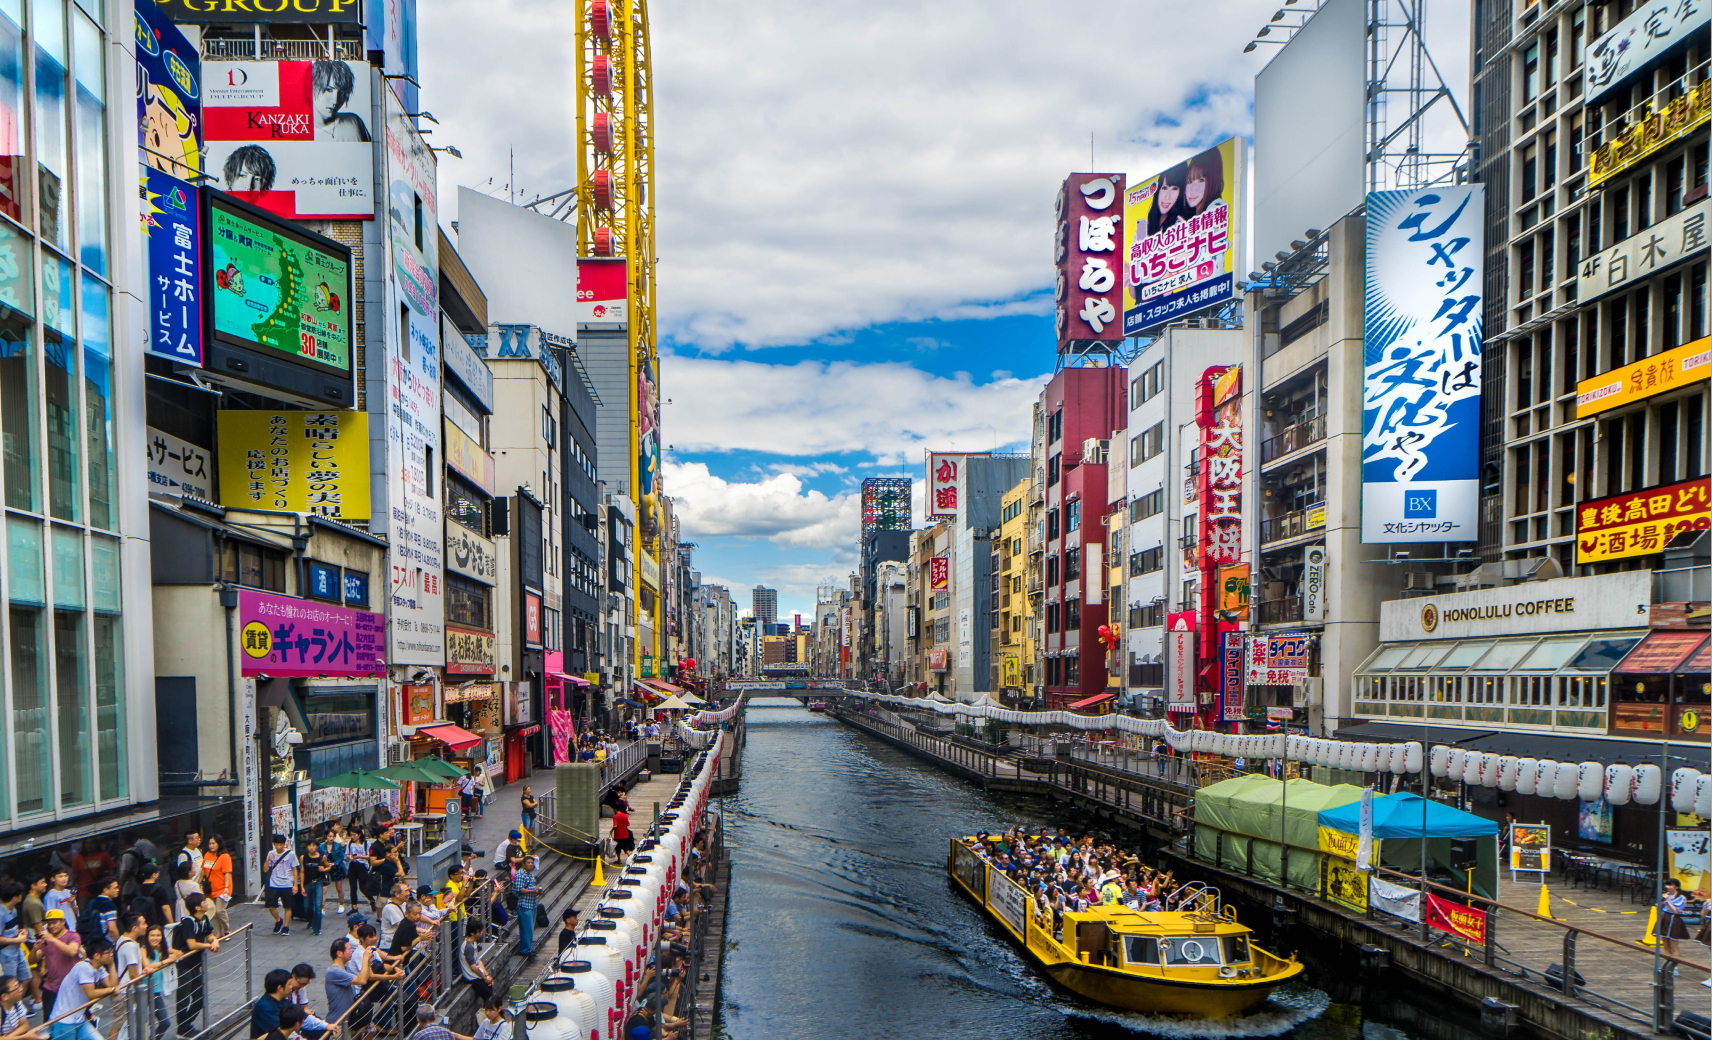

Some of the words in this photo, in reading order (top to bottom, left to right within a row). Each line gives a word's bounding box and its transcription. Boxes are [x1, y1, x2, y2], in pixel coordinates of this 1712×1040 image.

[247, 111, 309, 129] KANZAKI
[271, 123, 310, 138] RUKA
[291, 176, 358, 186] めっちゃ面白いを
[338, 188, 367, 198] 仕事に。
[1130, 205, 1228, 260] 高収入お仕事情報
[1079, 175, 1121, 334] づぼらや
[1130, 222, 1228, 285] いちごナビ
[1582, 255, 1601, 279] 4F
[1608, 211, 1708, 288] 白木屋
[172, 221, 196, 357] 富士ホーム
[1143, 279, 1176, 298] いちごナビ
[1178, 272, 1193, 285] 求人
[157, 274, 172, 346] サービス
[1126, 279, 1230, 328] 店舗・スタッフ求人も掲載中!
[301, 332, 316, 358] 30
[269, 414, 289, 509] あなたのお店づくり
[304, 412, 343, 518] 素晴らしい夢の実現
[246, 449, 267, 502] 応援します
[1409, 497, 1433, 512] BX
[1579, 485, 1711, 531] 豊後高田どり
[1600, 524, 1660, 555] 酒場
[318, 569, 327, 594] 酒
[938, 559, 947, 579] ツルハ
[1309, 565, 1319, 594] ZERO
[344, 577, 361, 599] たばこ
[424, 571, 442, 596] 最高!
[258, 601, 353, 627] あなたも憧れのお店のオーナーに!
[1443, 603, 1512, 622] HONOLULU
[1515, 597, 1575, 616] COFFEE
[245, 629, 269, 650] 賃貸
[273, 622, 355, 665] ギャラント
[1252, 638, 1267, 667] 薬
[1269, 639, 1306, 657] ダイコク
[270, 652, 277, 664] の
[1228, 650, 1240, 686] ダイコク
[1266, 669, 1290, 684] 免税
